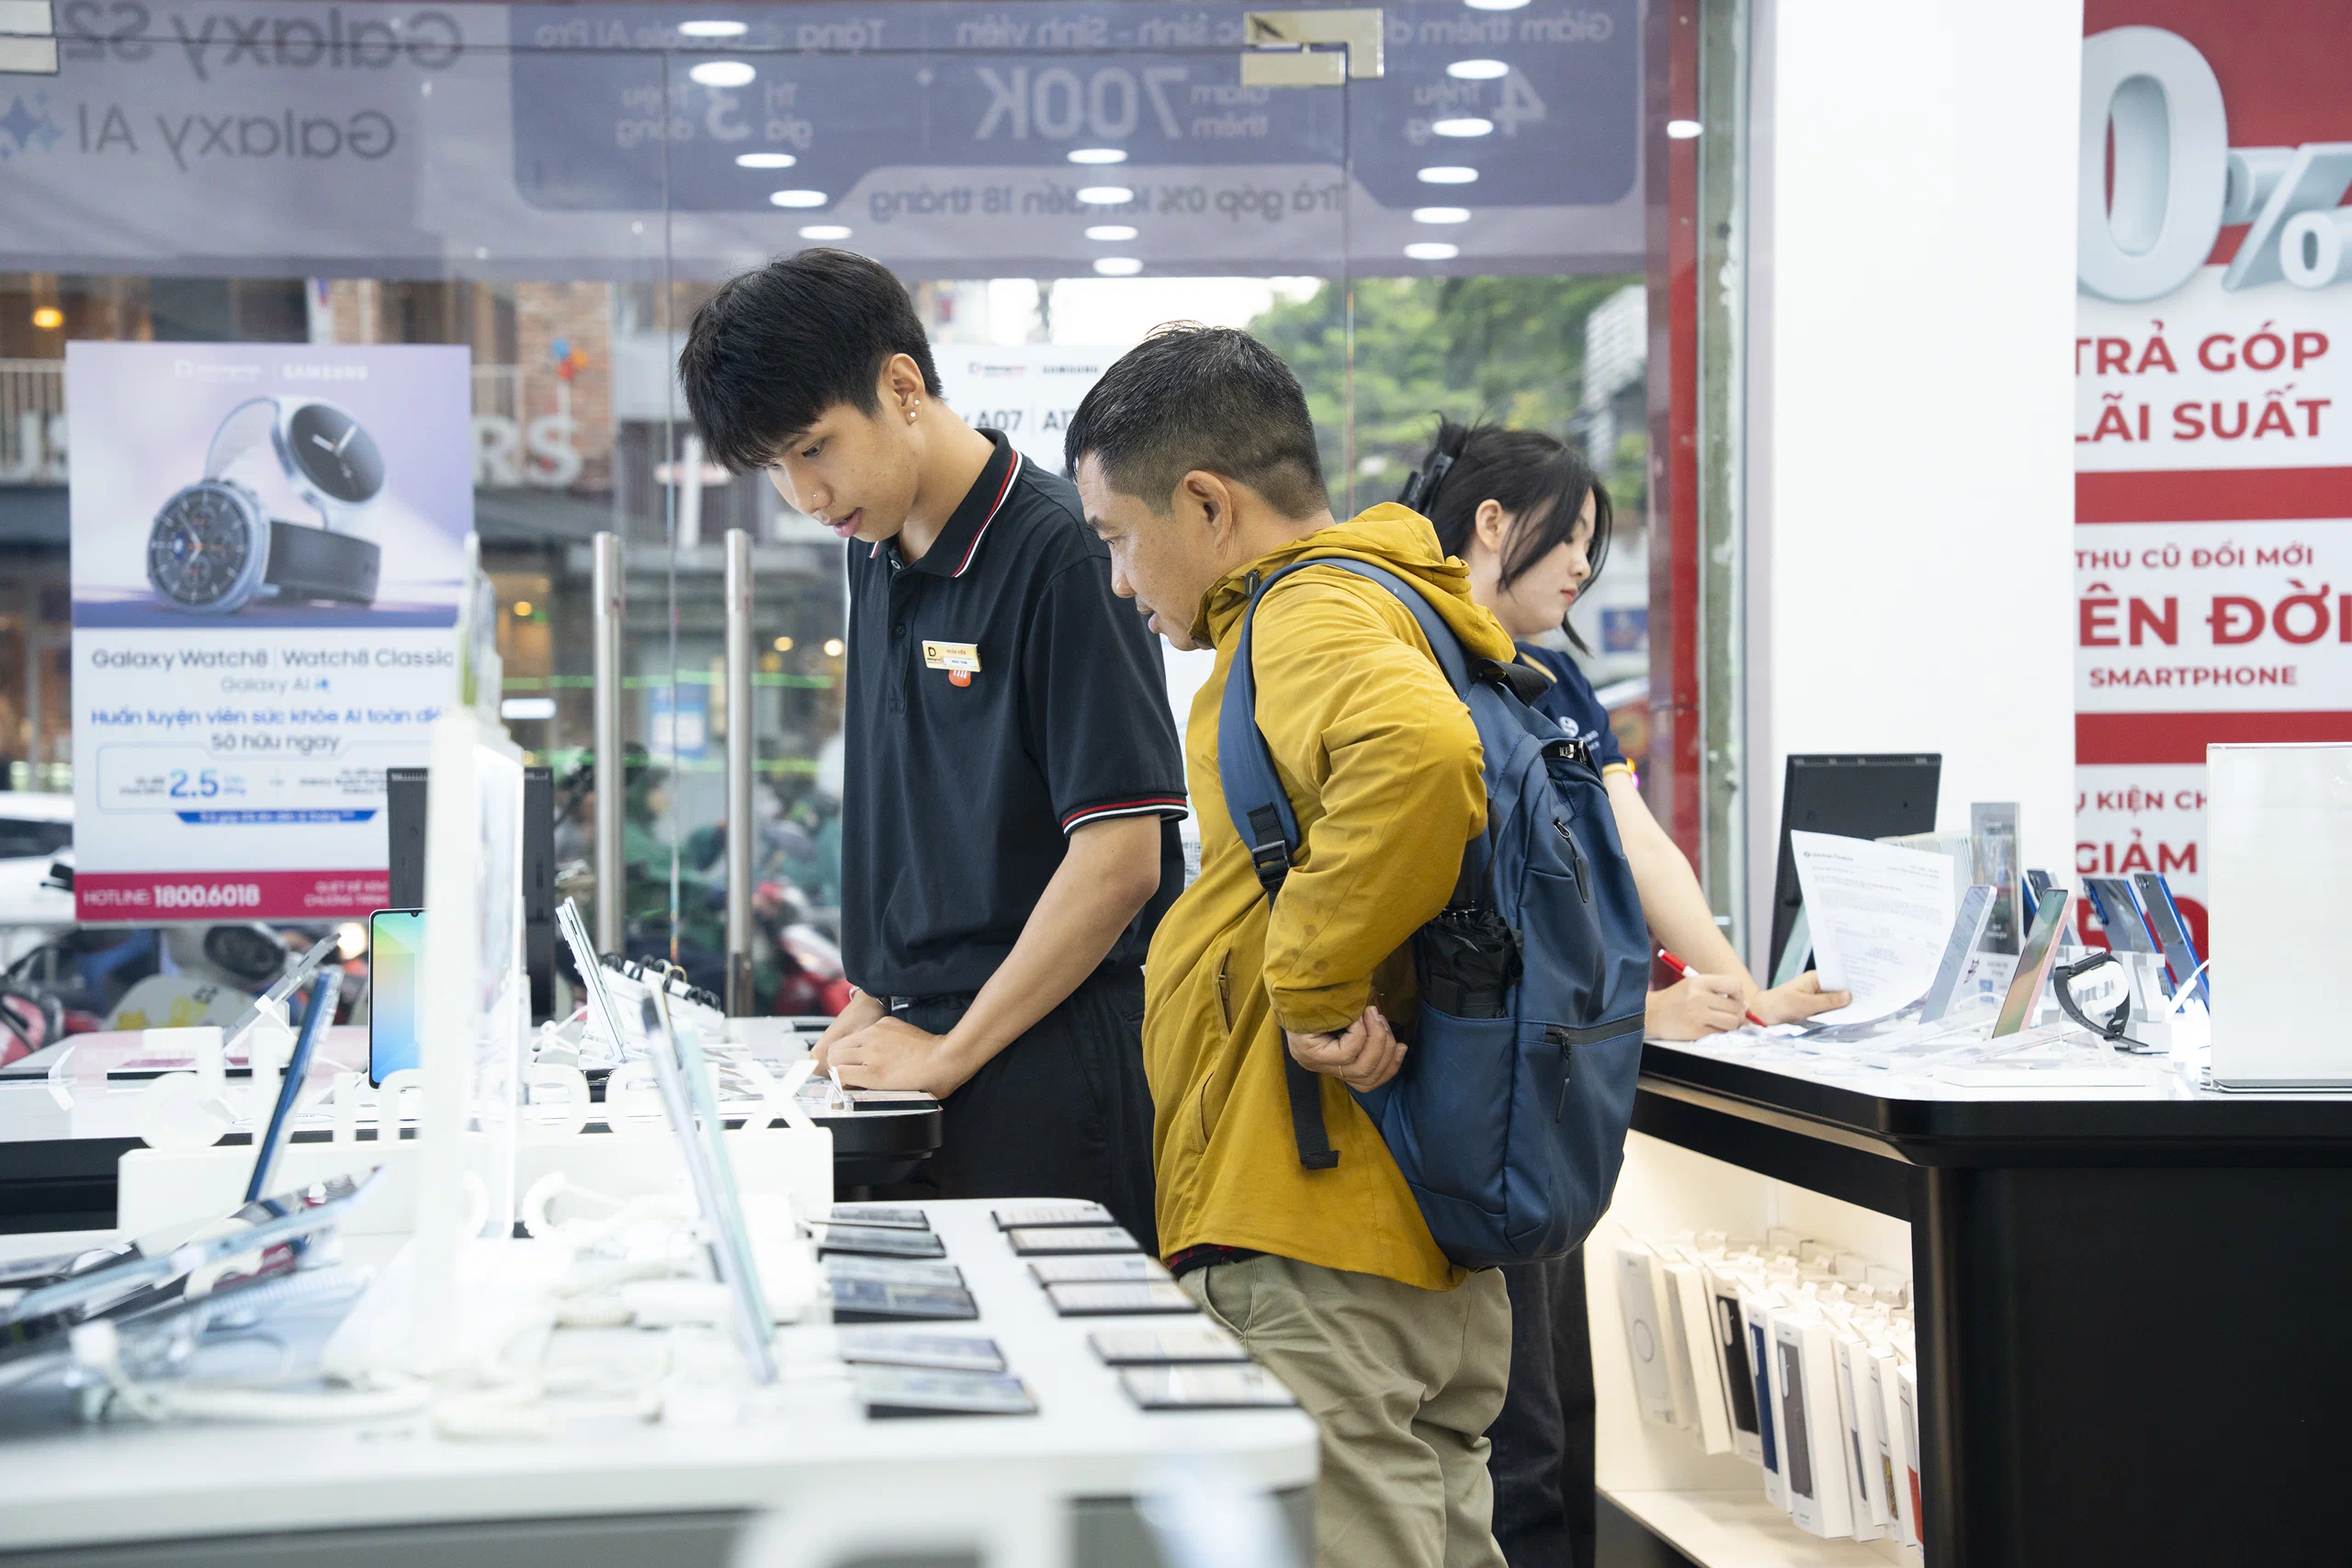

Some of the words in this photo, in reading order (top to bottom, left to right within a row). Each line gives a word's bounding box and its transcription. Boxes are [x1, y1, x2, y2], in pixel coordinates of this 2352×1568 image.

[2197, 320, 2330, 373] GÓP
[976, 410, 1023, 432] A07
[2172, 383, 2332, 442] SUẤT
[2075, 549, 2132, 570] THU
[2142, 542, 2181, 569] CŨ
[2191, 538, 2245, 568] ĐỔI
[2256, 541, 2313, 567] MỚI
[2205, 578, 2352, 646] ĐỜI
[92, 649, 175, 671] Galaxy
[375, 647, 455, 669] Classic
[220, 677, 287, 694] Galaxy
[2089, 665, 2298, 688] SMARTPHONE
[287, 735, 340, 755] ngay
[169, 769, 220, 798] 2.5
[2097, 784, 2165, 817] KIỆN
[2075, 827, 2198, 874] GIẢM
